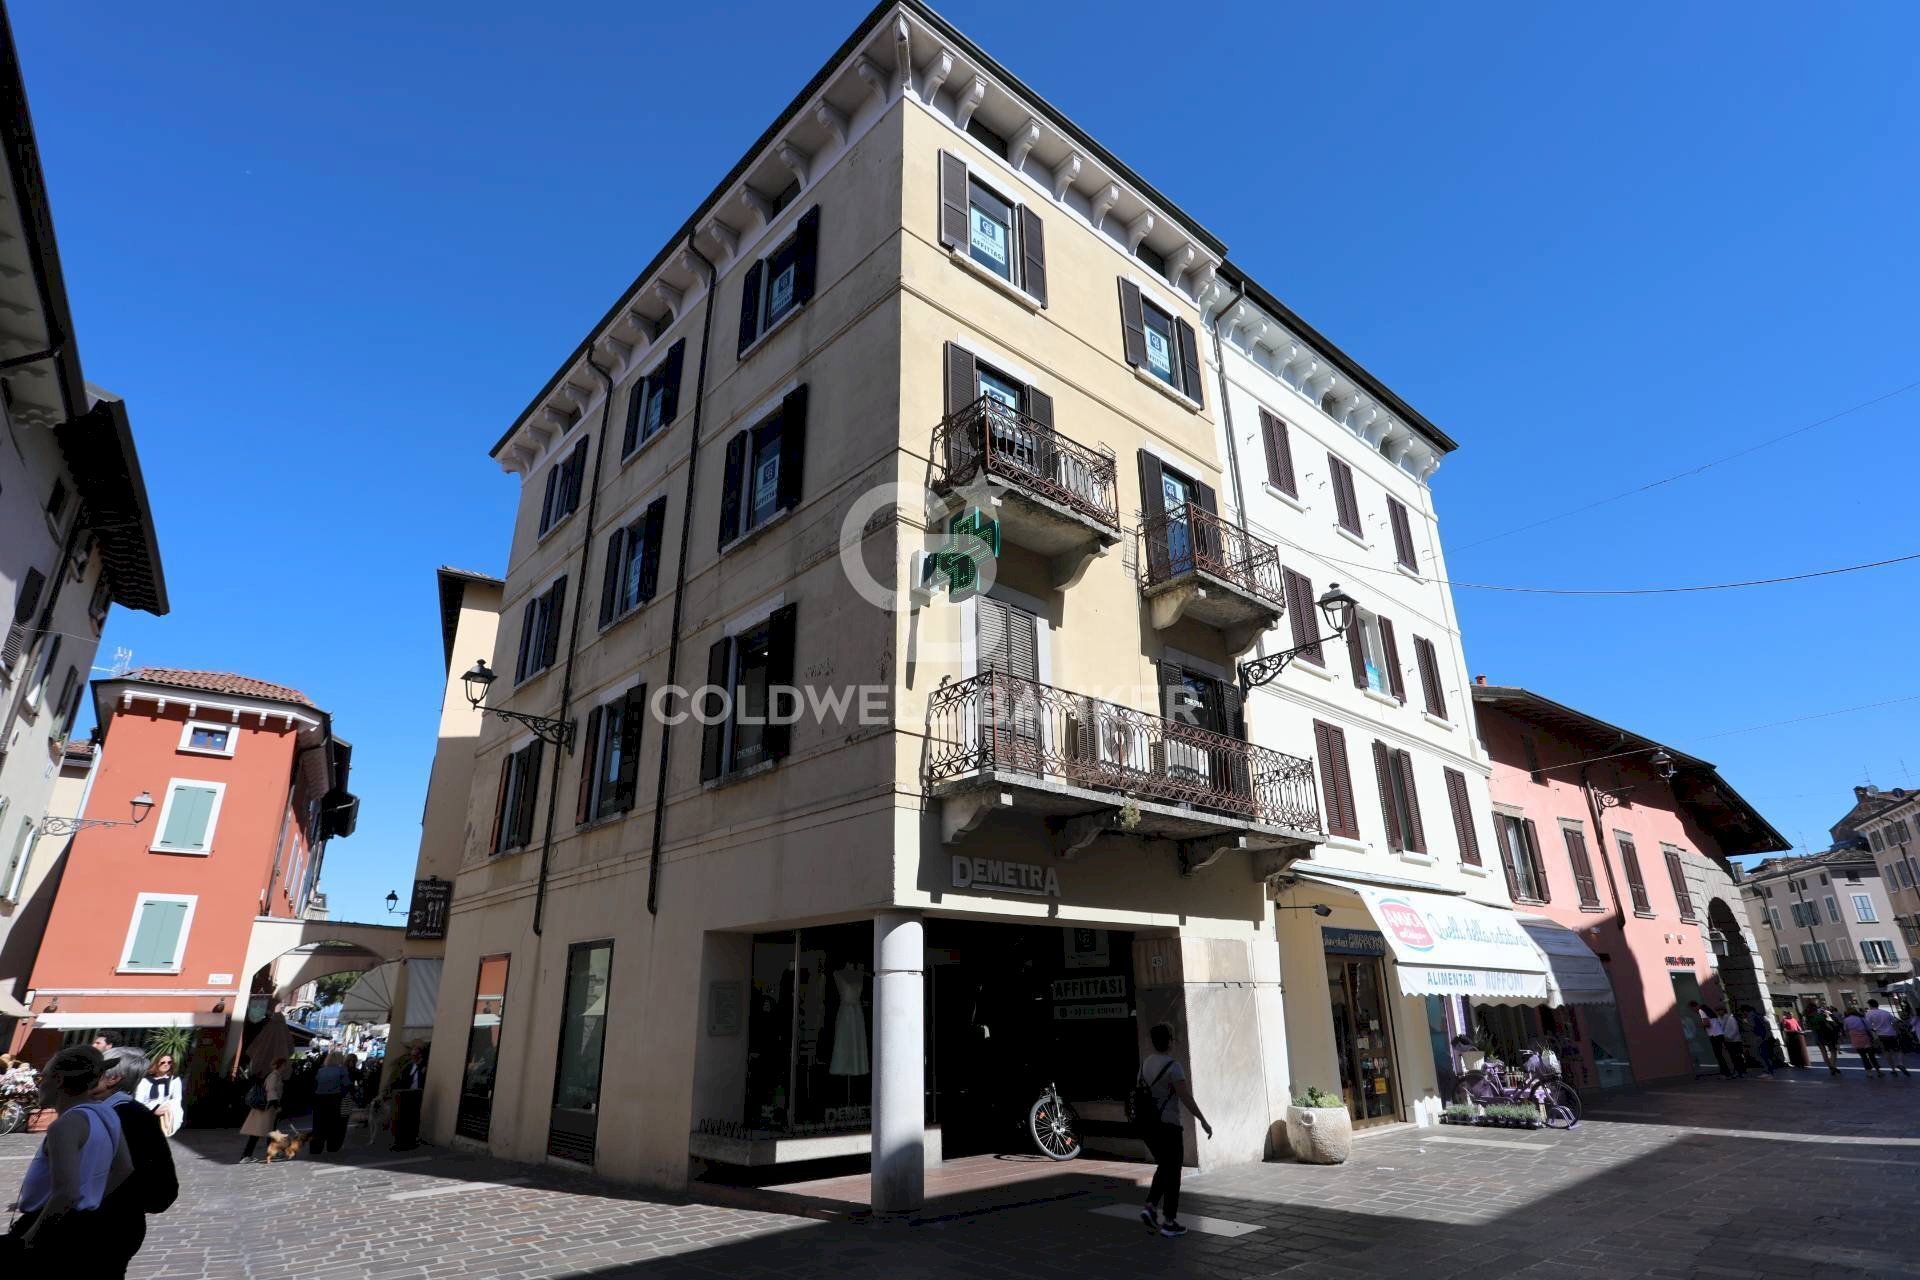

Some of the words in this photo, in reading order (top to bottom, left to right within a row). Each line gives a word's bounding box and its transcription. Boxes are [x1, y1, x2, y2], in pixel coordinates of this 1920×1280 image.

[972, 237, 1004, 262] AFFITTASI
[951, 855, 1062, 898] DEMETRA
[1055, 978, 1123, 998] AFFITTASI
[1427, 971, 1476, 987] ALIMENTARI
